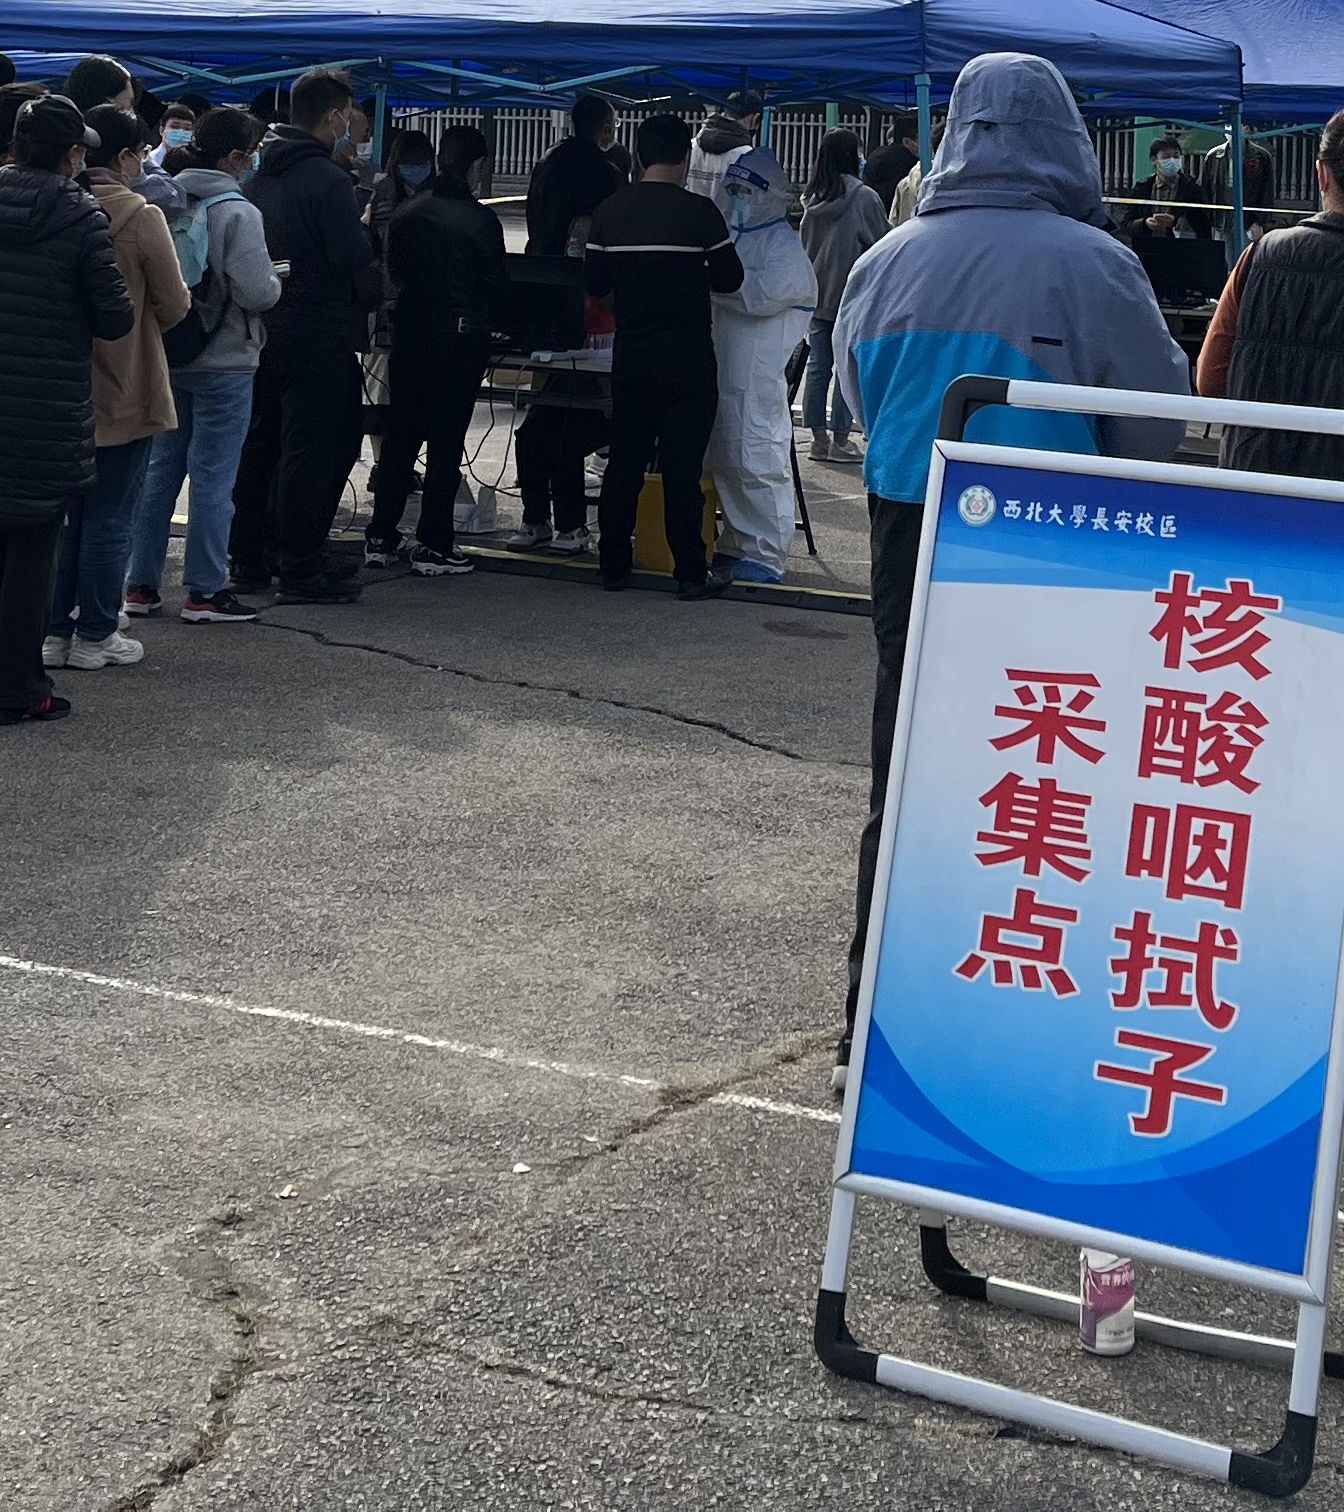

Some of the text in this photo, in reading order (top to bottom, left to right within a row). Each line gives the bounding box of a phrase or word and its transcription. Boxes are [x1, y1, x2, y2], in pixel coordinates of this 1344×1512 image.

[957, 668, 1108, 998] 采集点
[1097, 572, 1281, 1136] 核酸咽拭子
